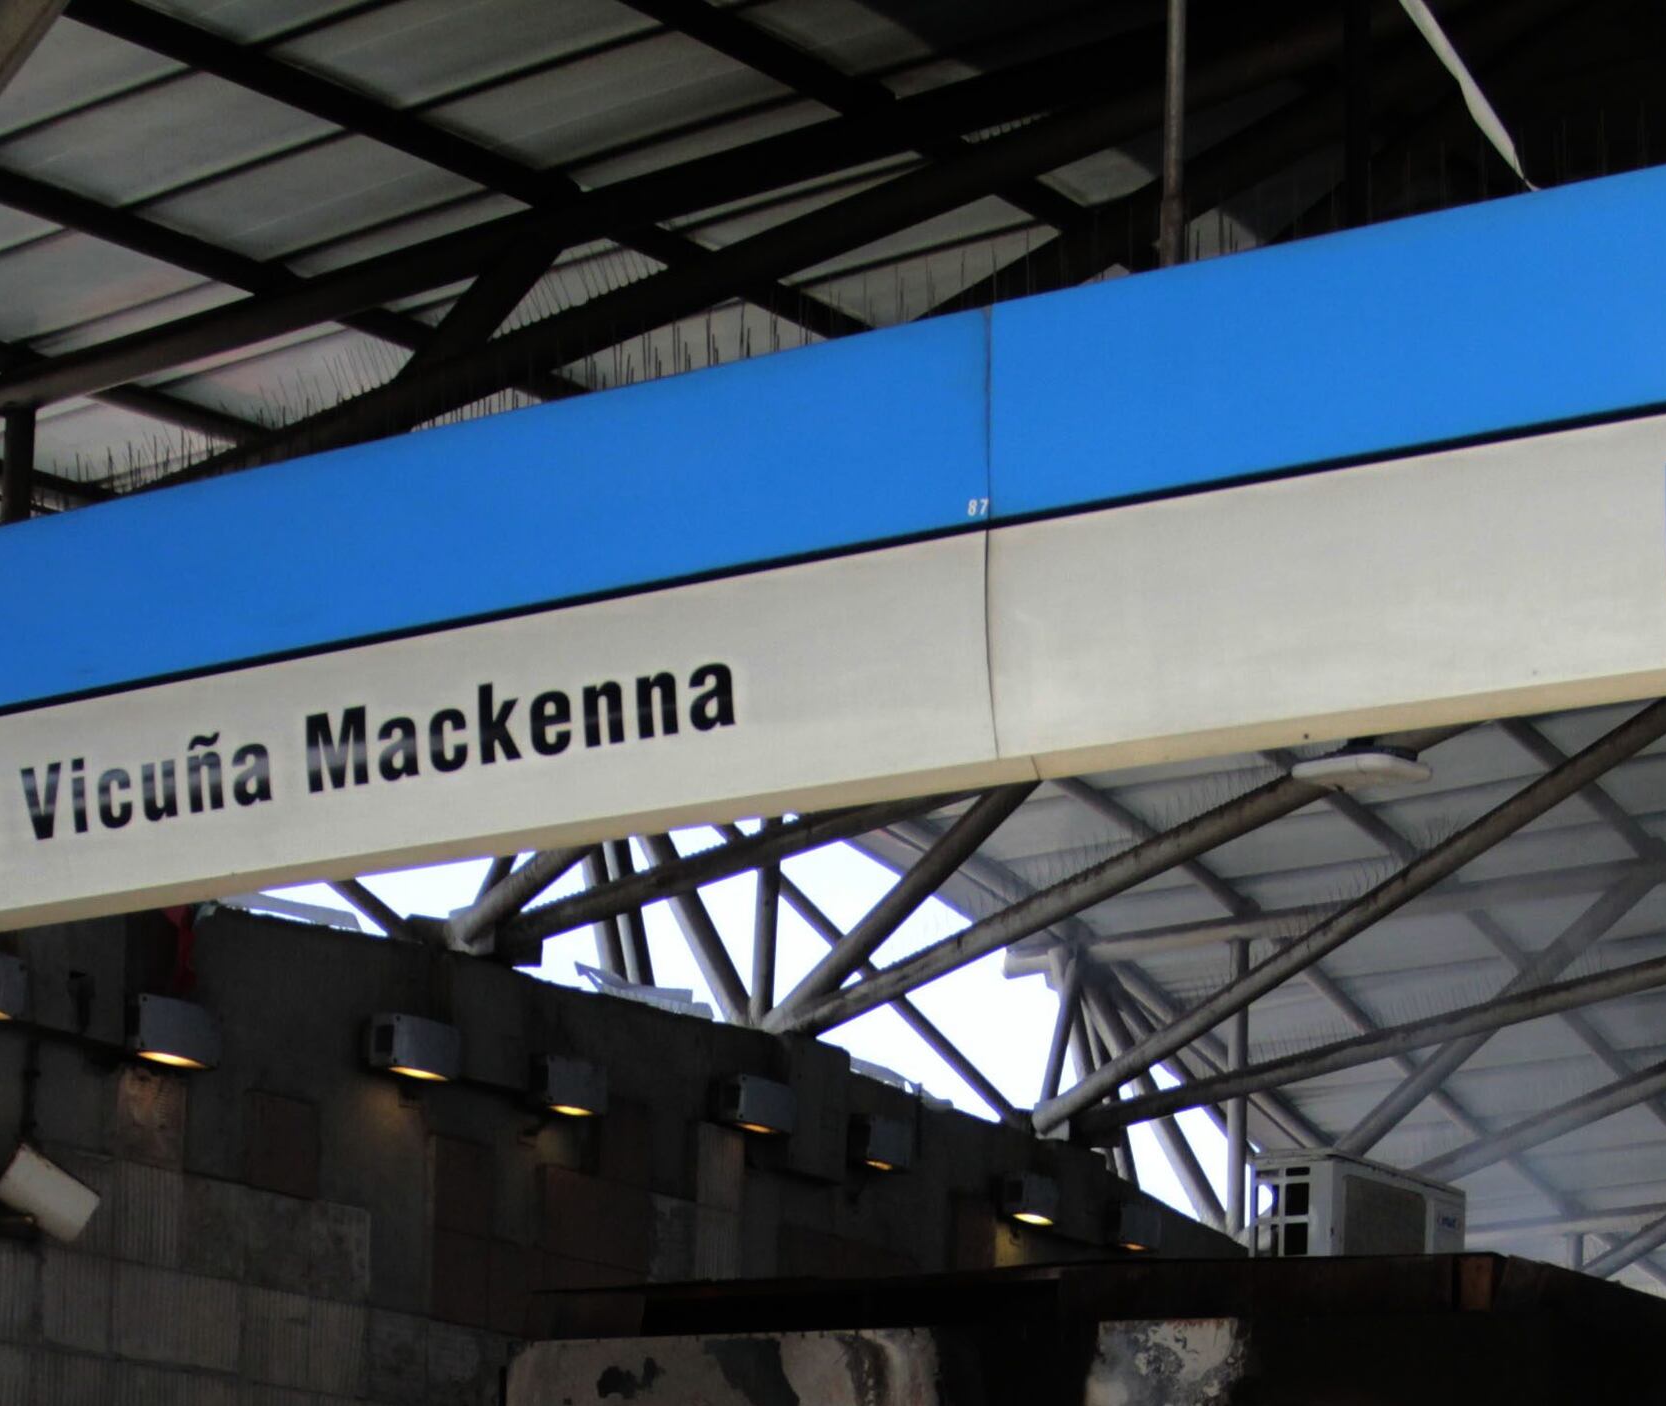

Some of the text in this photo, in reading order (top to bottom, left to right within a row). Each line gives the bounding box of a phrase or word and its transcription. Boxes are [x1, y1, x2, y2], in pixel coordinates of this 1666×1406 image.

[967, 498, 989, 516] 87
[20, 732, 273, 841] Vicuña
[305, 663, 735, 786] Mackenna
